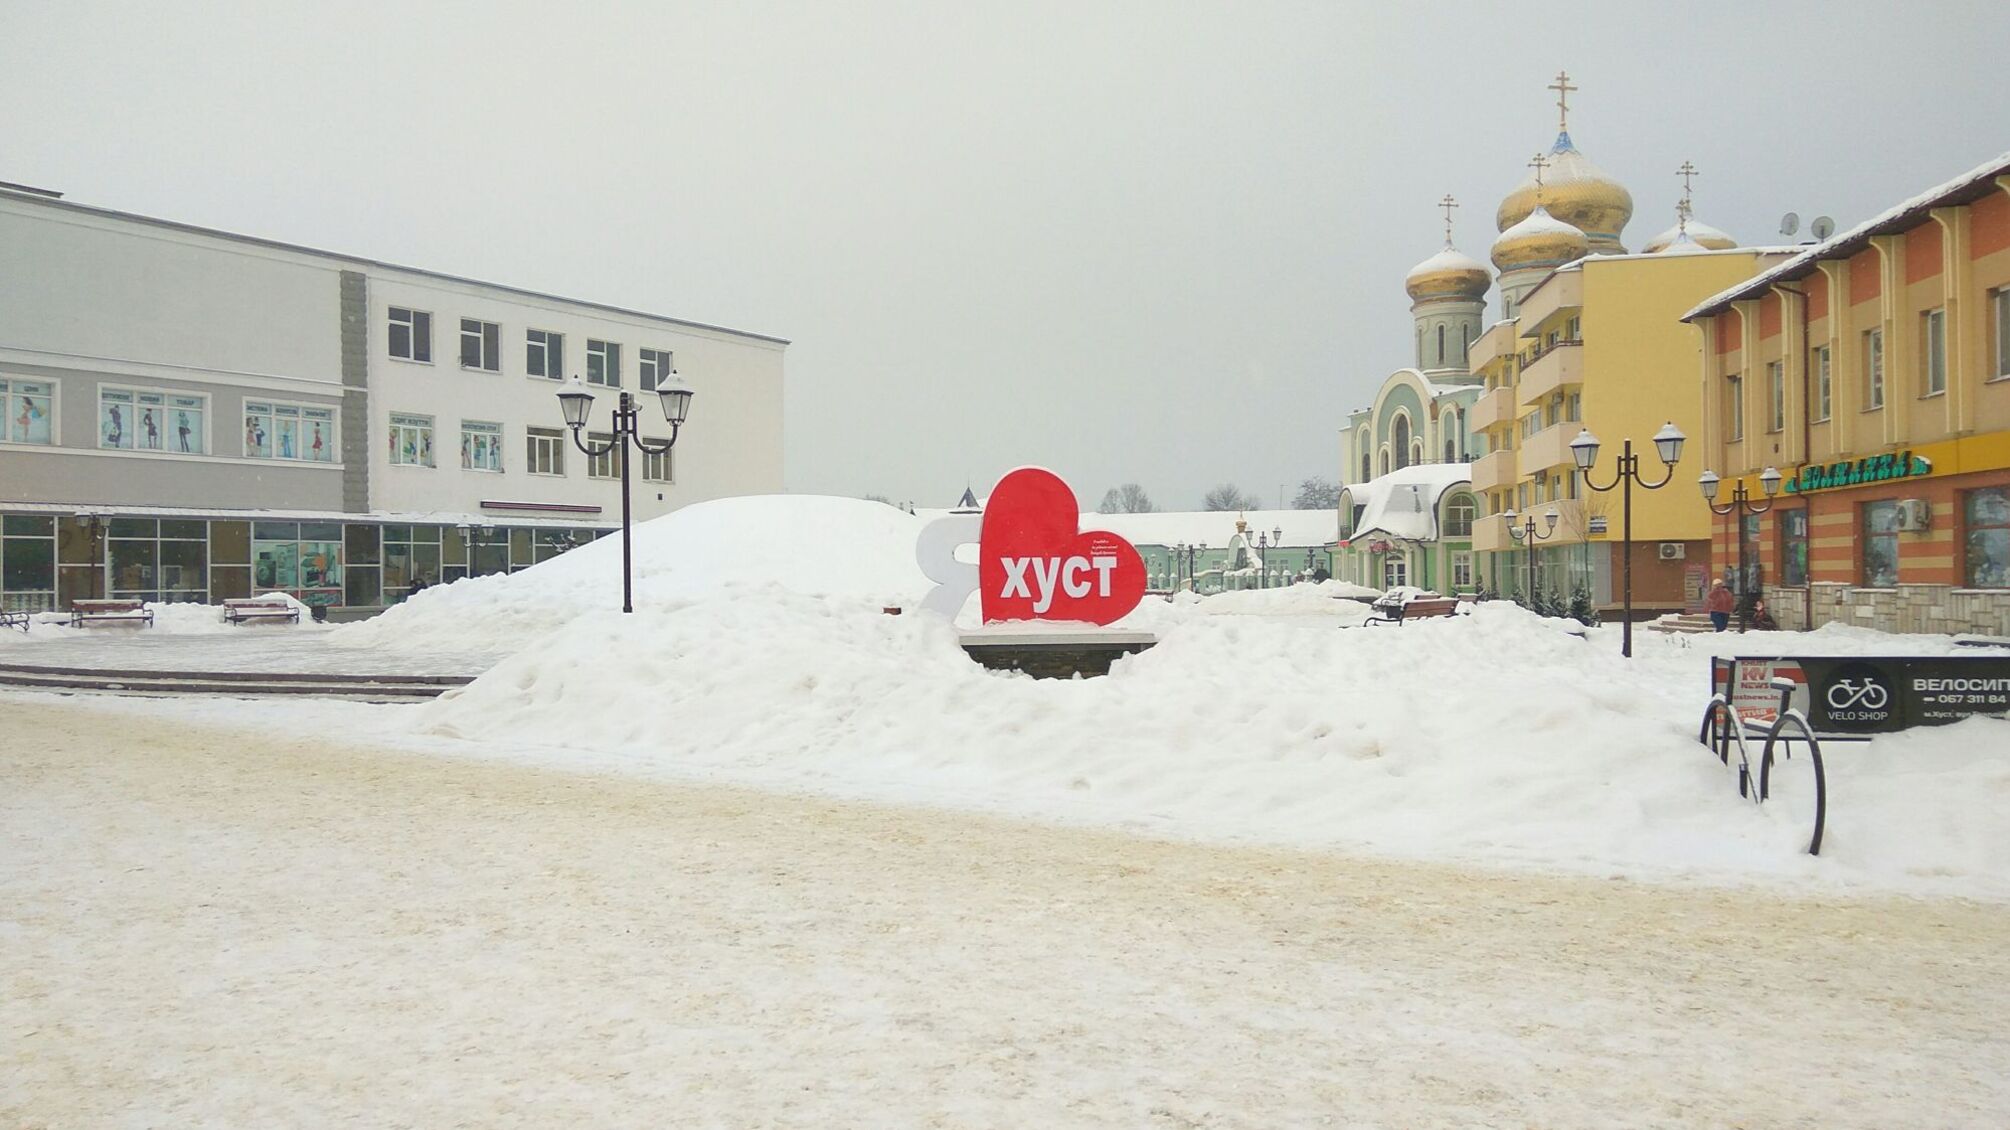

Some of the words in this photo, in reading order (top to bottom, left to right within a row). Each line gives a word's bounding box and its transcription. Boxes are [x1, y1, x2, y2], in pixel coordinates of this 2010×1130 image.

[1913, 678, 2010, 691] ВЕЛОСИП
[1938, 694, 1964, 703] 067
[1967, 694, 1985, 703] 311
[1988, 694, 2007, 703] 84
[1827, 711, 1856, 721] VELO
[1858, 711, 1889, 721] SHOP
